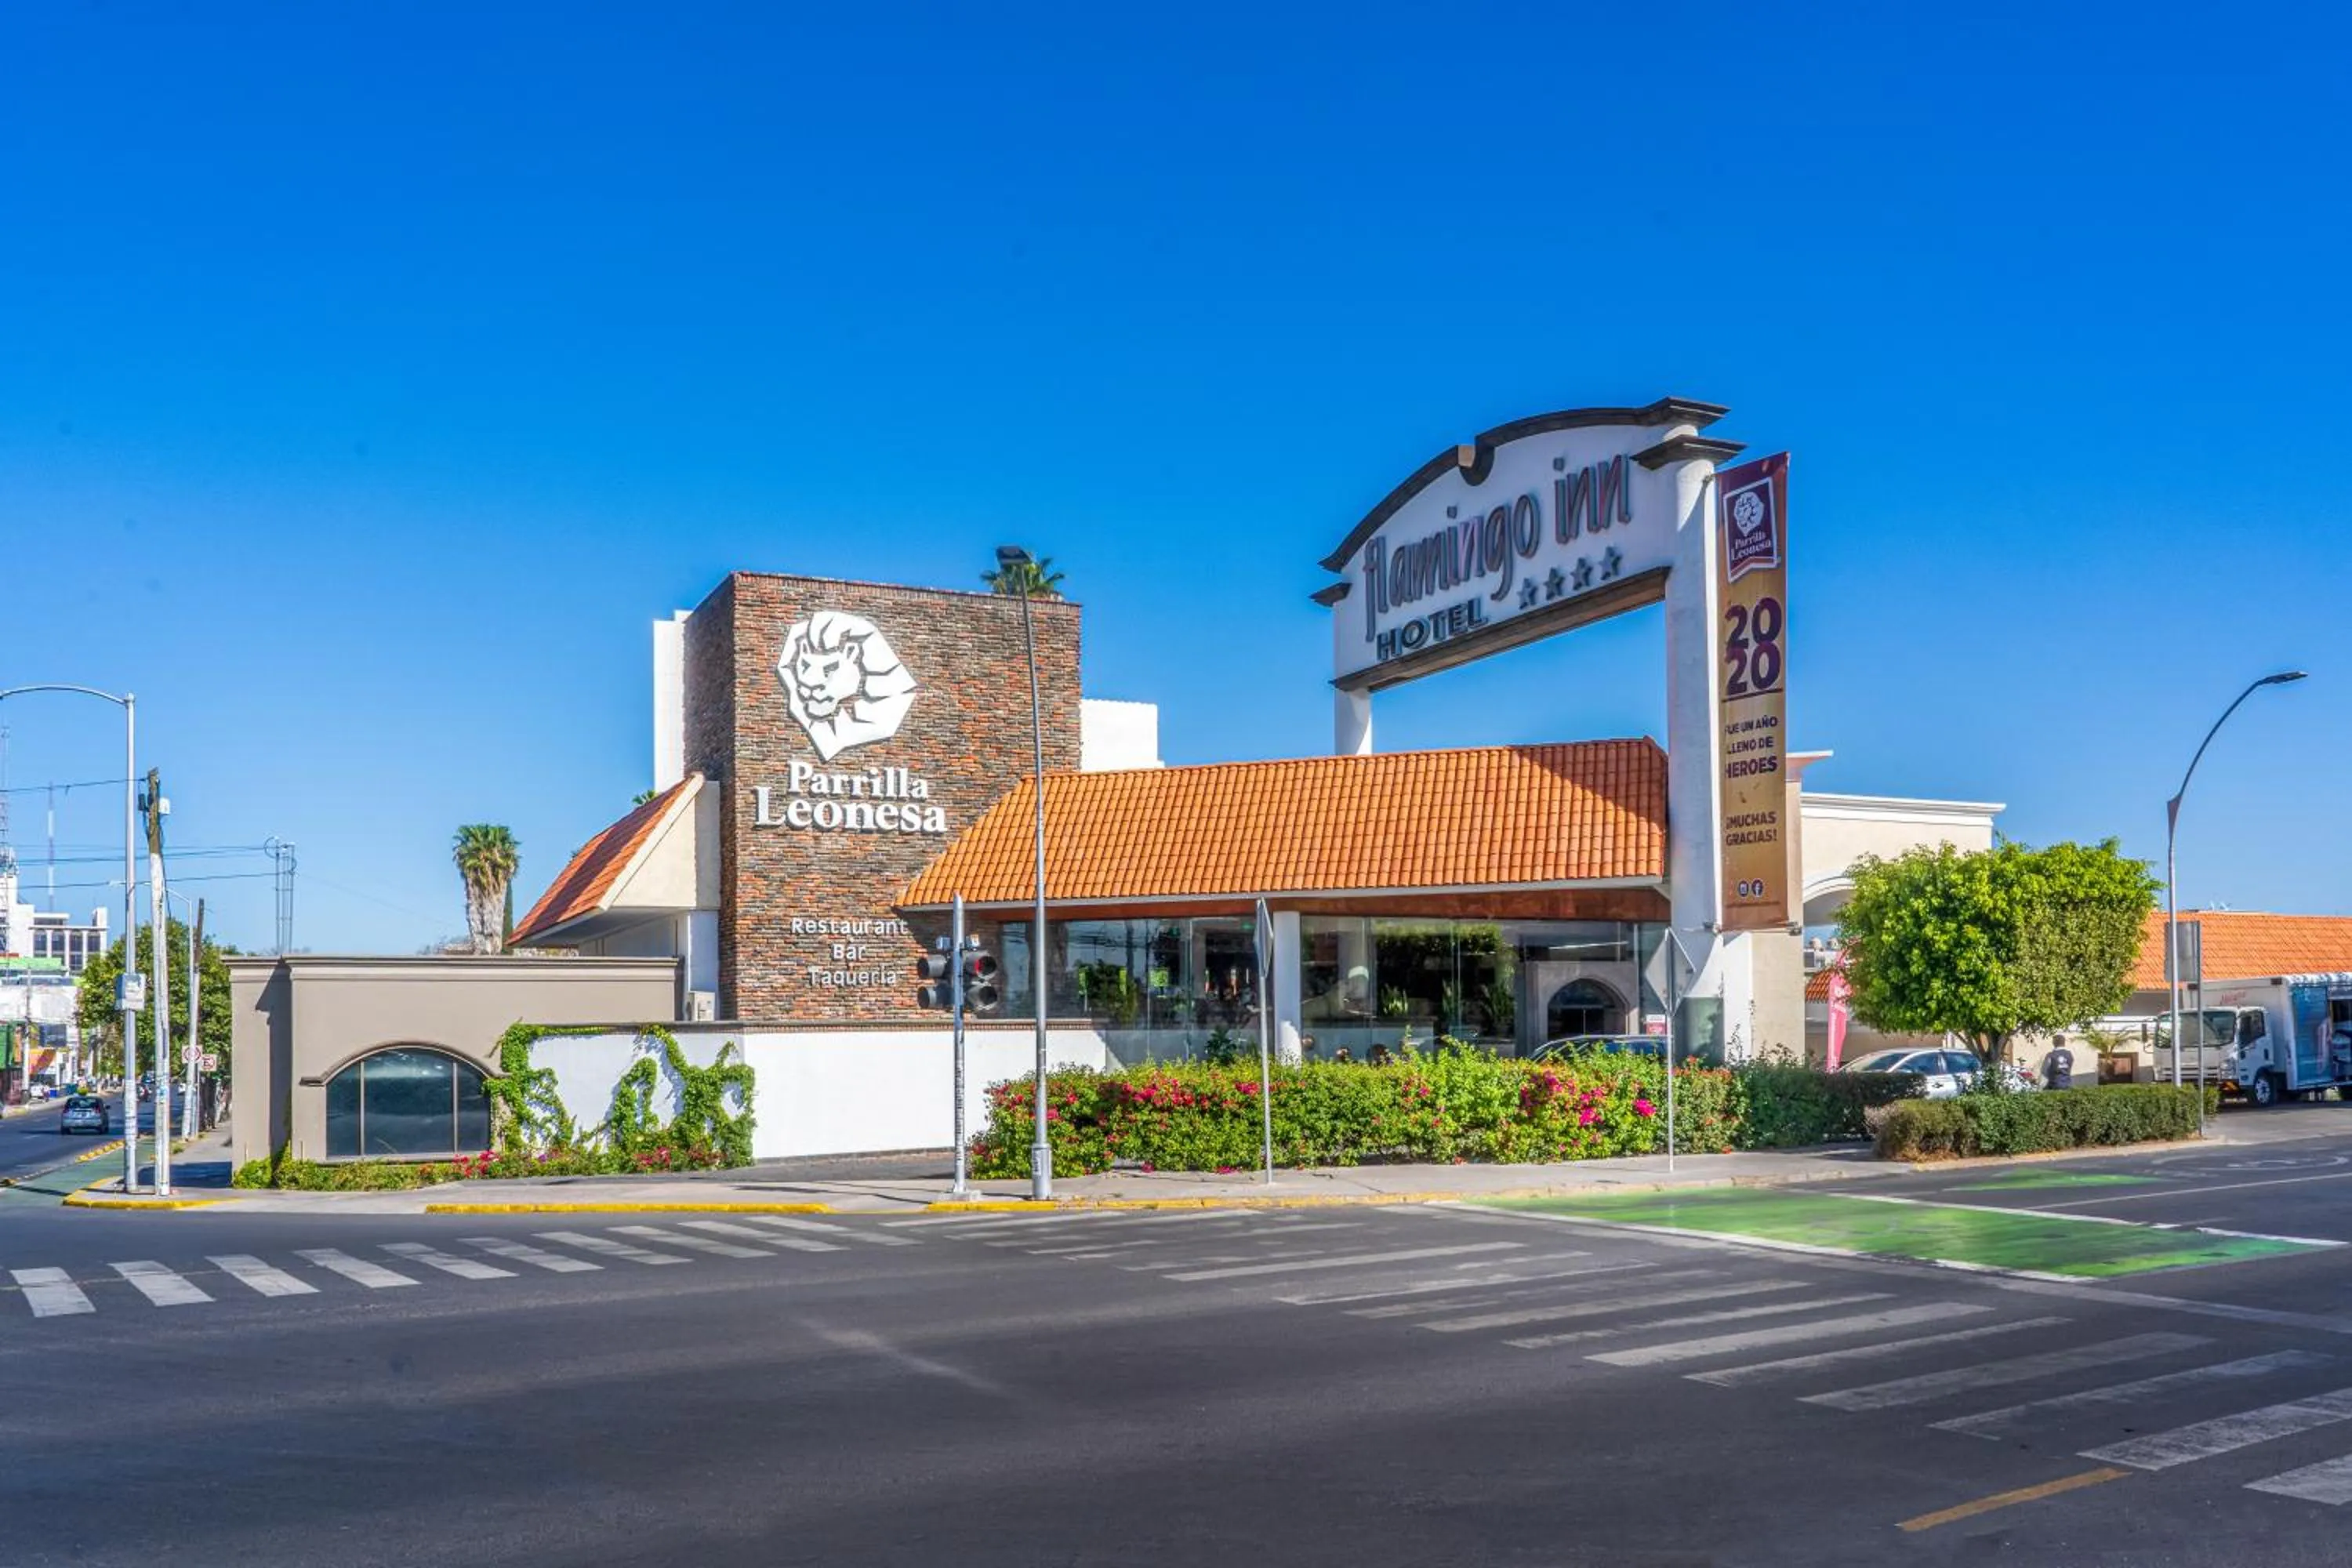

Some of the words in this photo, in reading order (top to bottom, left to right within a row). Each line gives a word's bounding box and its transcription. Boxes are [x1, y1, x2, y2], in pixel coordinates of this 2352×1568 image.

[1363, 493, 1541, 642] flamingo
[1553, 454, 1632, 545] inn
[1377, 597, 1490, 660] HOTEL
[1725, 596, 1782, 651] 20
[1725, 641, 1781, 695] 20
[1740, 720, 1754, 733] UN
[1755, 714, 1778, 728] AÑO
[1759, 736, 1774, 749] DE
[788, 761, 929, 799] Parrilla
[753, 786, 947, 833] Leonesa
[1726, 829, 1777, 846] GRACIAS!
[791, 917, 909, 935] Restaurant
[832, 943, 866, 960] Bar
